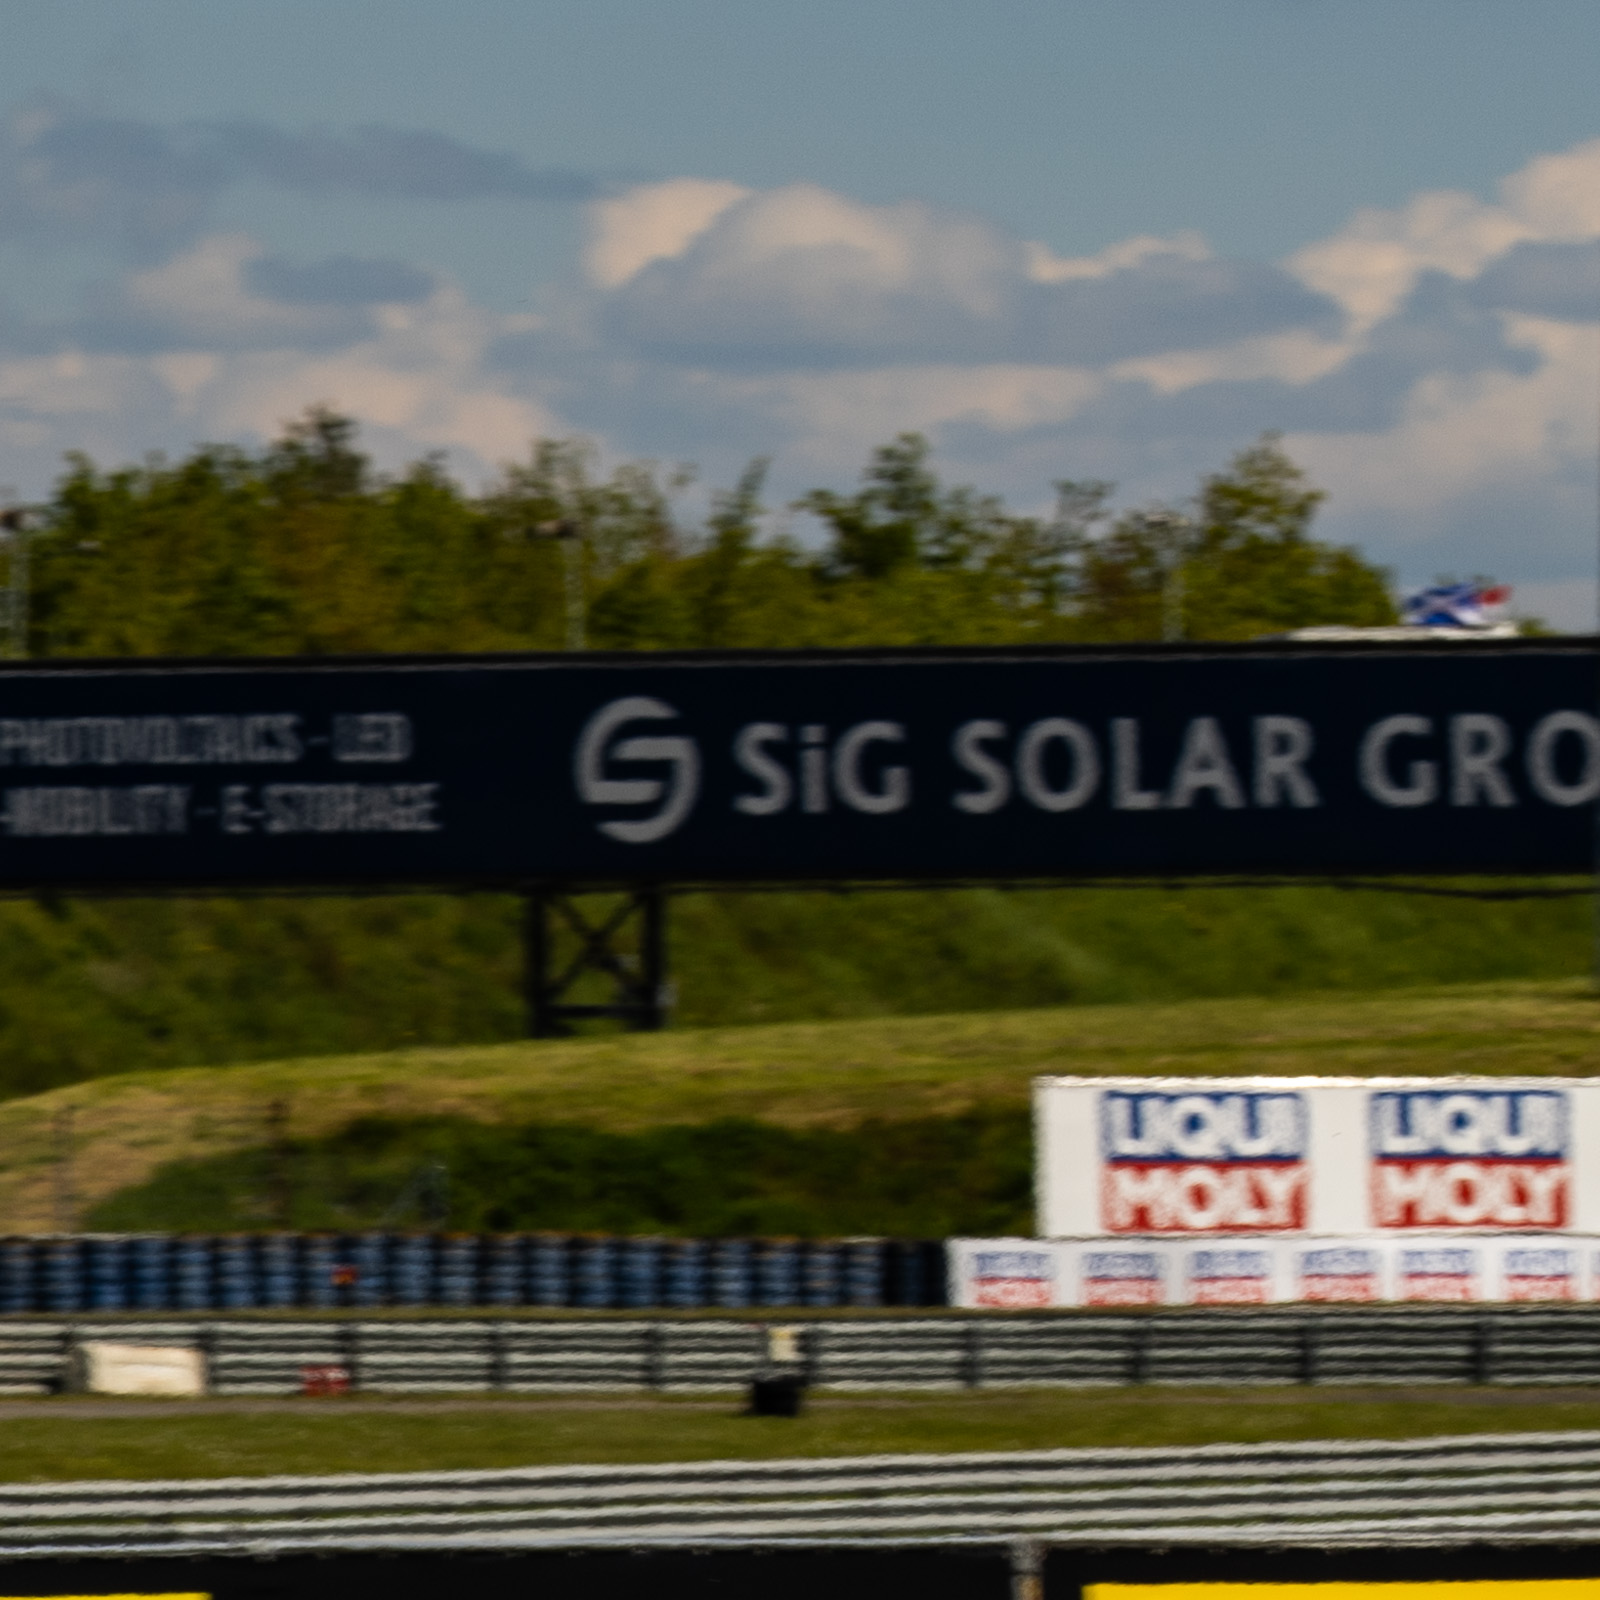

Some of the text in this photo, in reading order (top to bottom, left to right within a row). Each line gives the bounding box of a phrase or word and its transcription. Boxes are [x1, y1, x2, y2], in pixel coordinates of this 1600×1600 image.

[733, 721, 911, 815] SiG
[952, 715, 1321, 813] SOLAR
[1109, 1094, 1304, 1157] LIQUI
[1376, 1092, 1566, 1156] LIQUI
[1109, 1164, 1304, 1228] MOLY
[1376, 1162, 1566, 1226] MOLY
